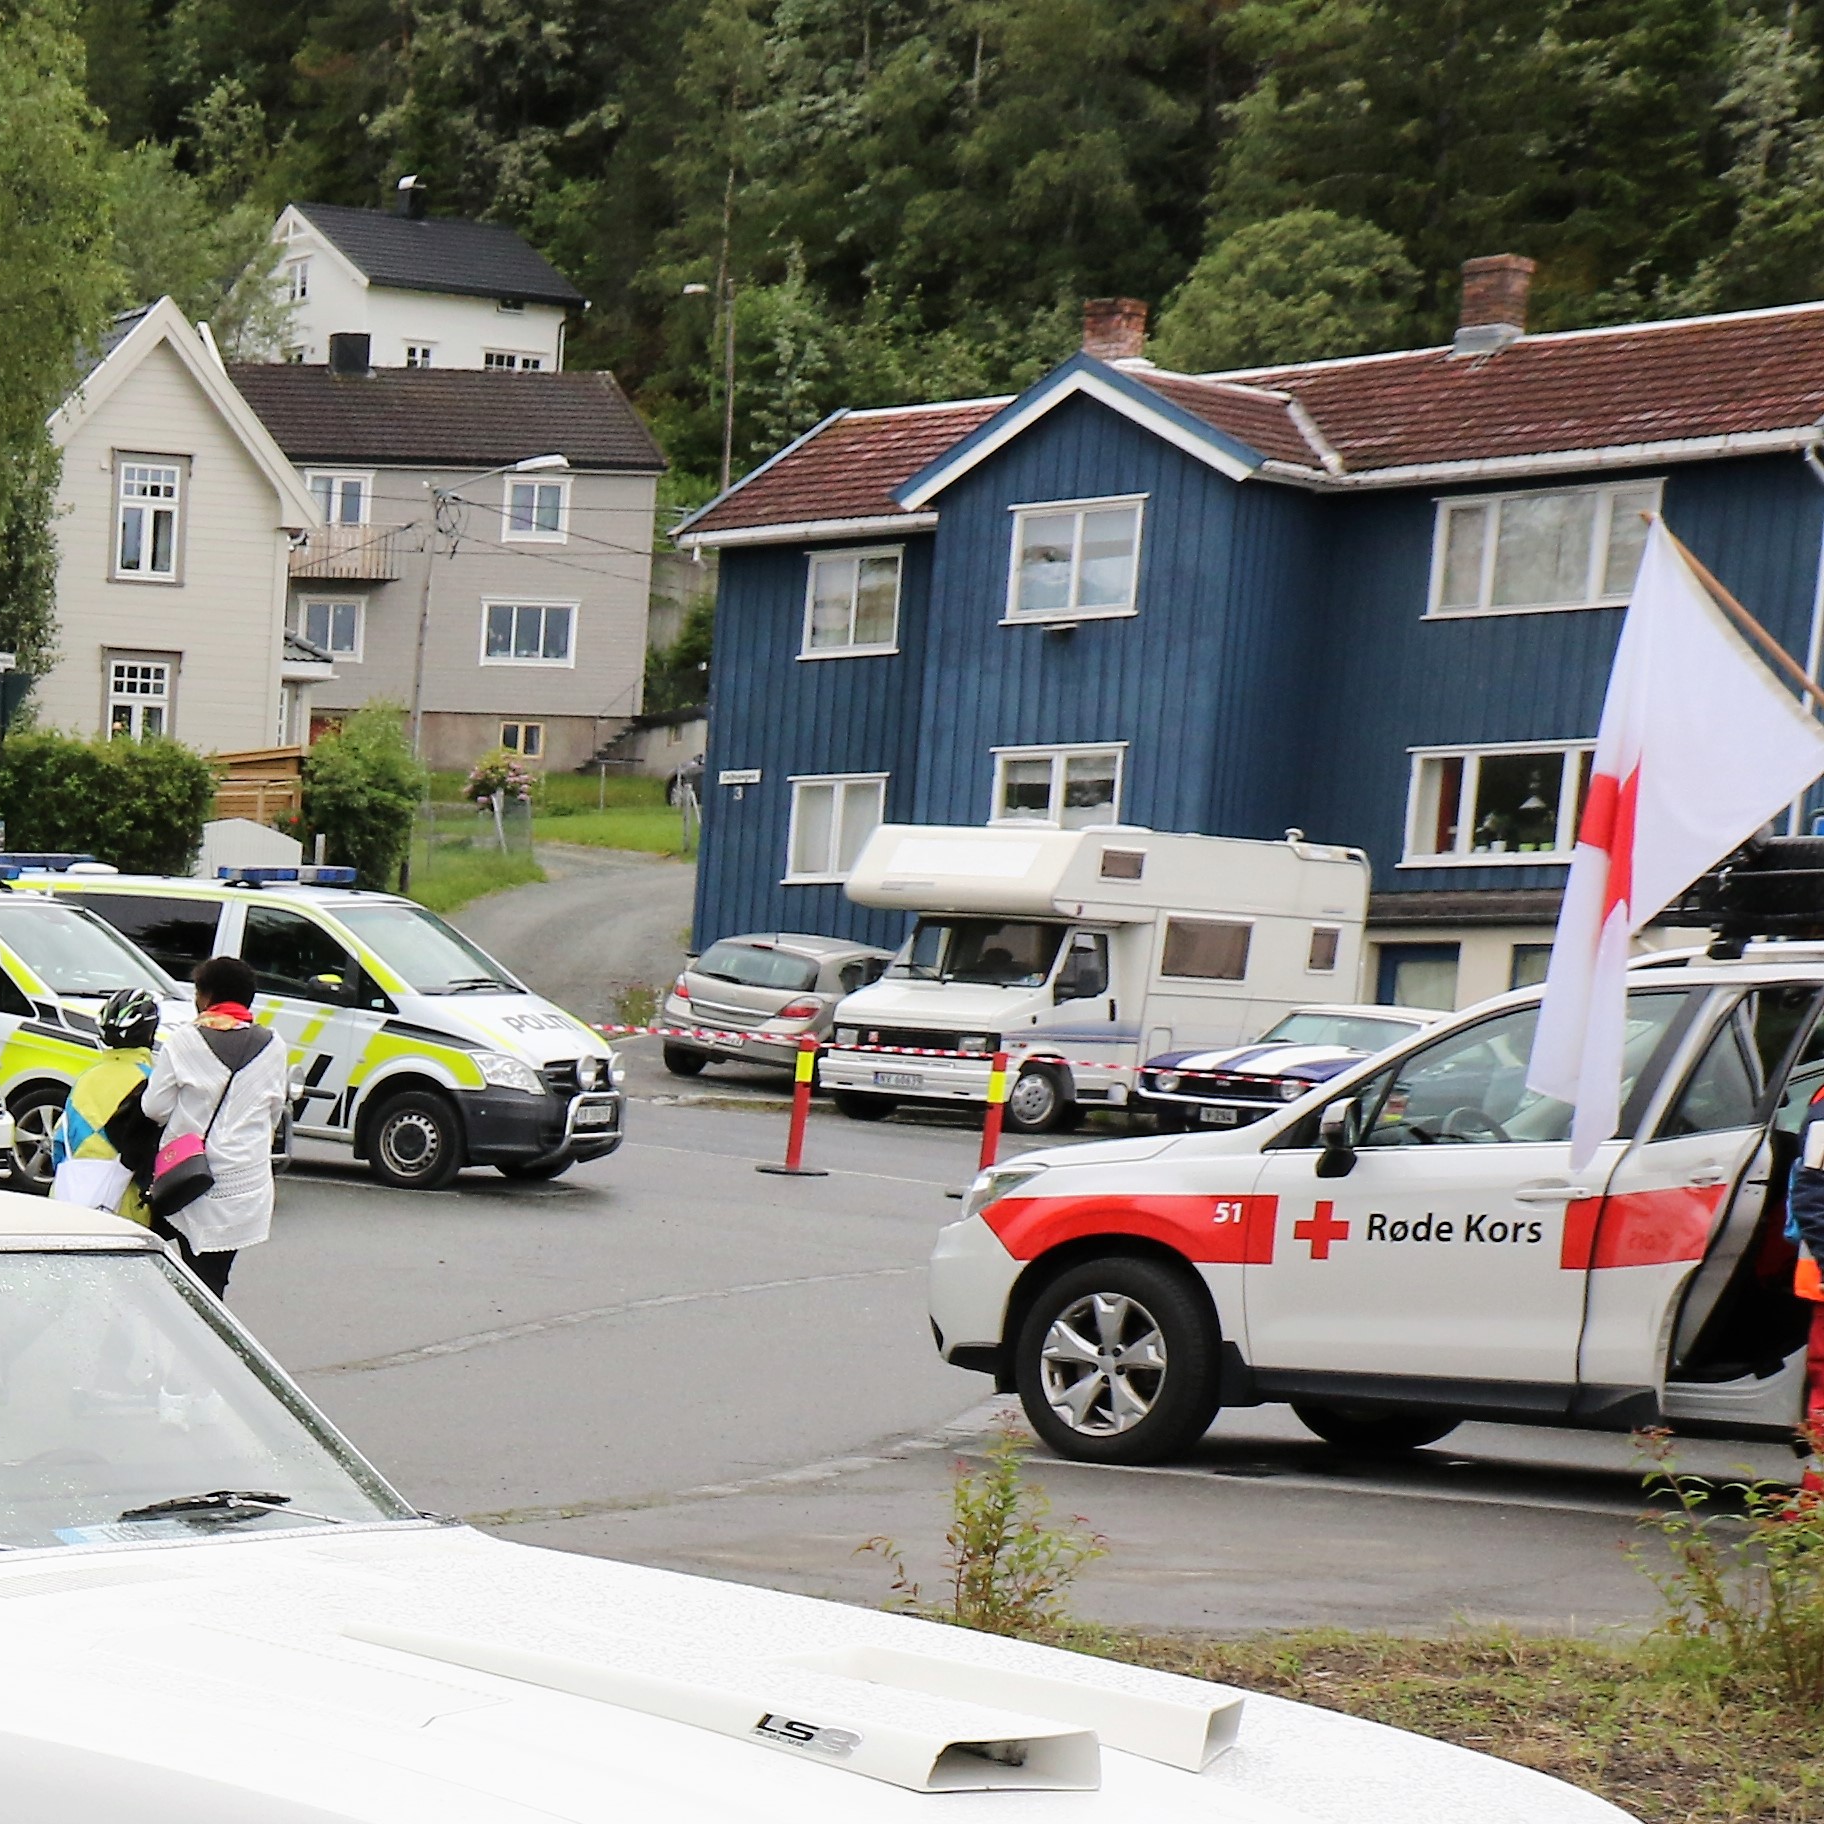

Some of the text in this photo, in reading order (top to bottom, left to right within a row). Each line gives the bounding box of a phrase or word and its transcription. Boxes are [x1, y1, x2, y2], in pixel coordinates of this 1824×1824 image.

[733, 785, 743, 800] 3
[1213, 1201, 1243, 1223] 51
[1367, 1211, 1543, 1244] Røde Kors
